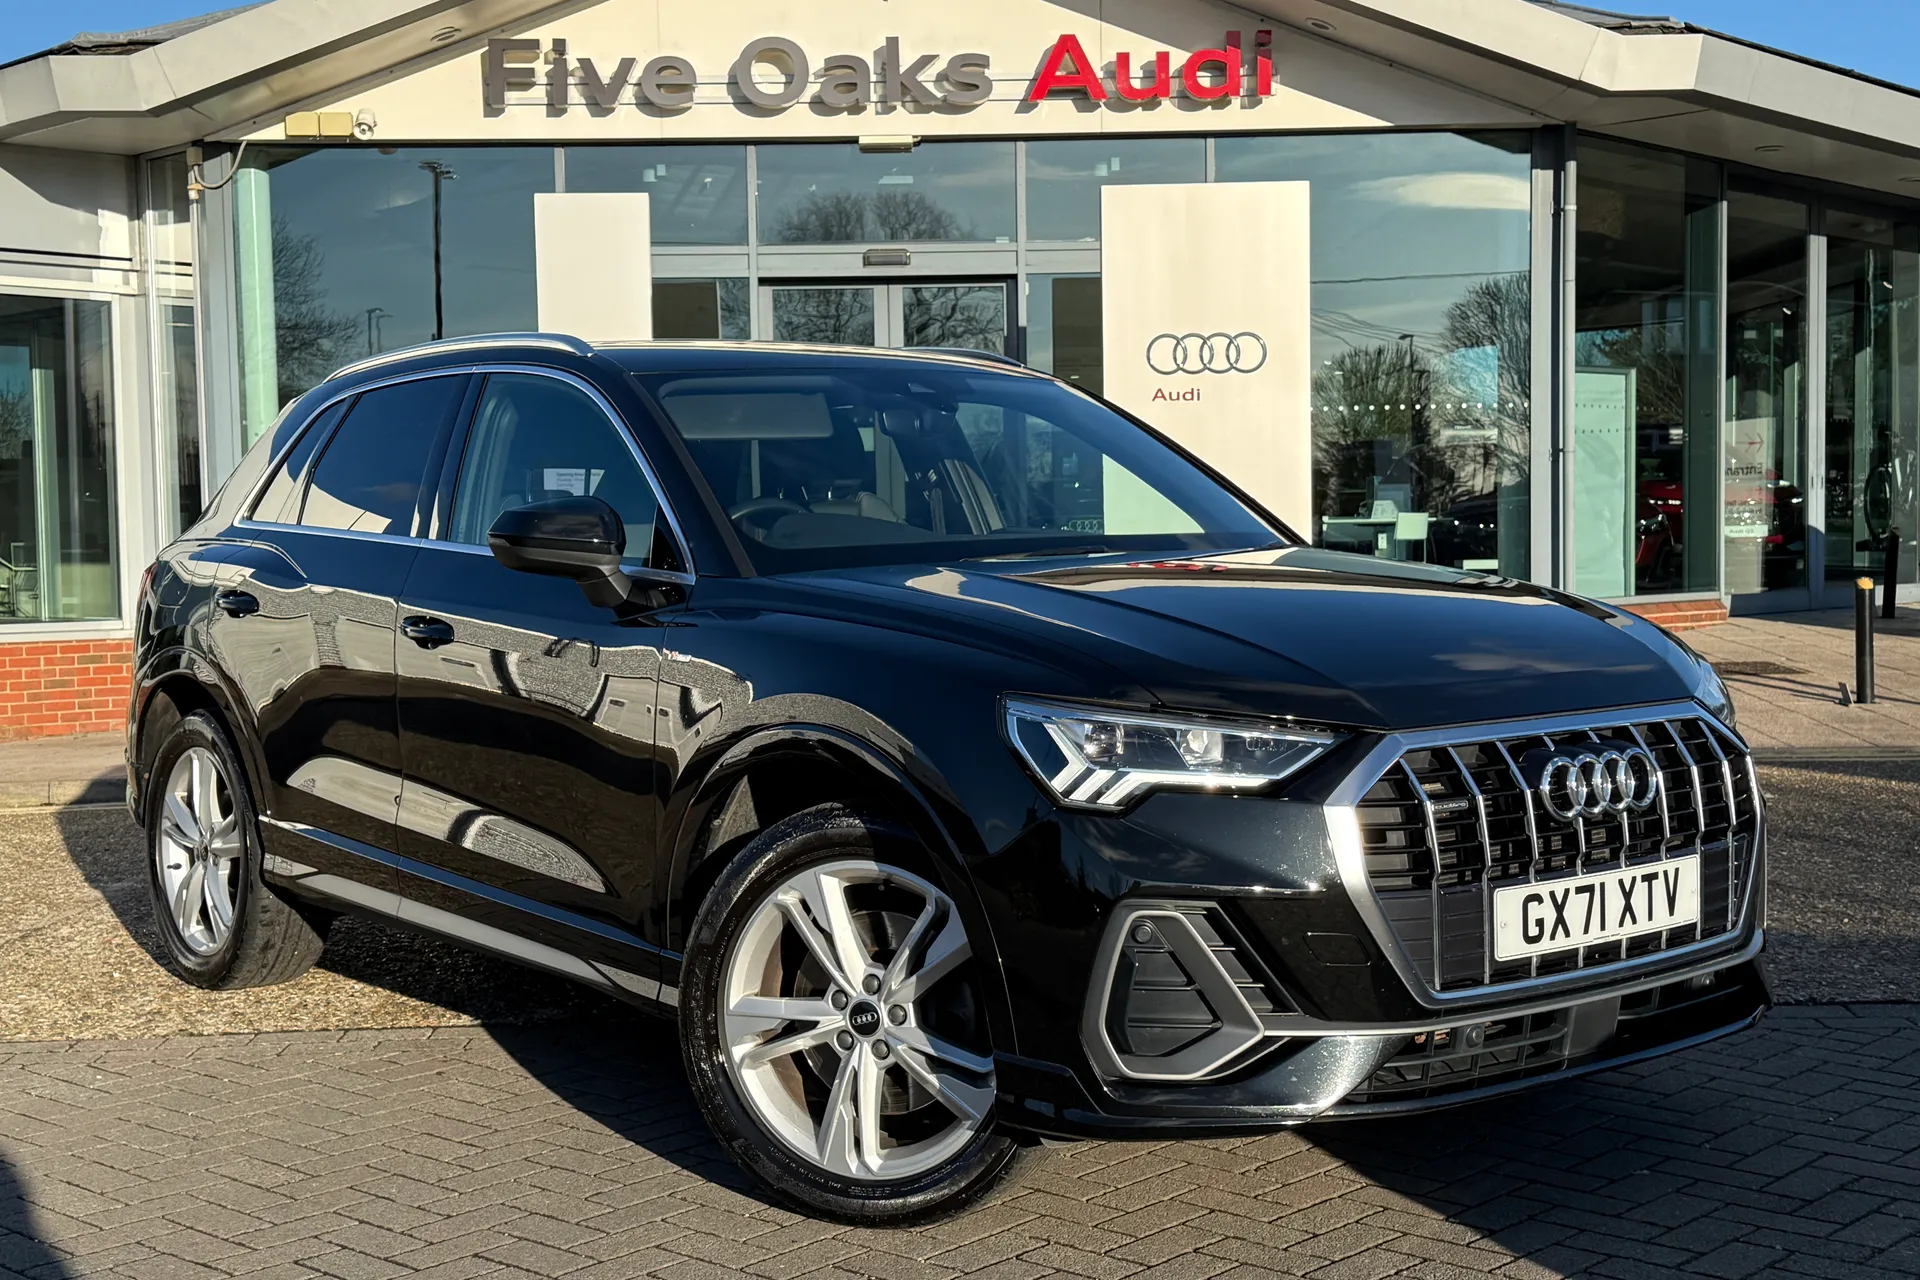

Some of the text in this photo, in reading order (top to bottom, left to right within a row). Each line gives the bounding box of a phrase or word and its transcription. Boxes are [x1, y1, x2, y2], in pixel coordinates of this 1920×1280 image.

[487, 29, 1273, 109] Five Oaks Audi
[1152, 387, 1201, 402] Audi
[1521, 867, 1680, 945] GX71 XTV
